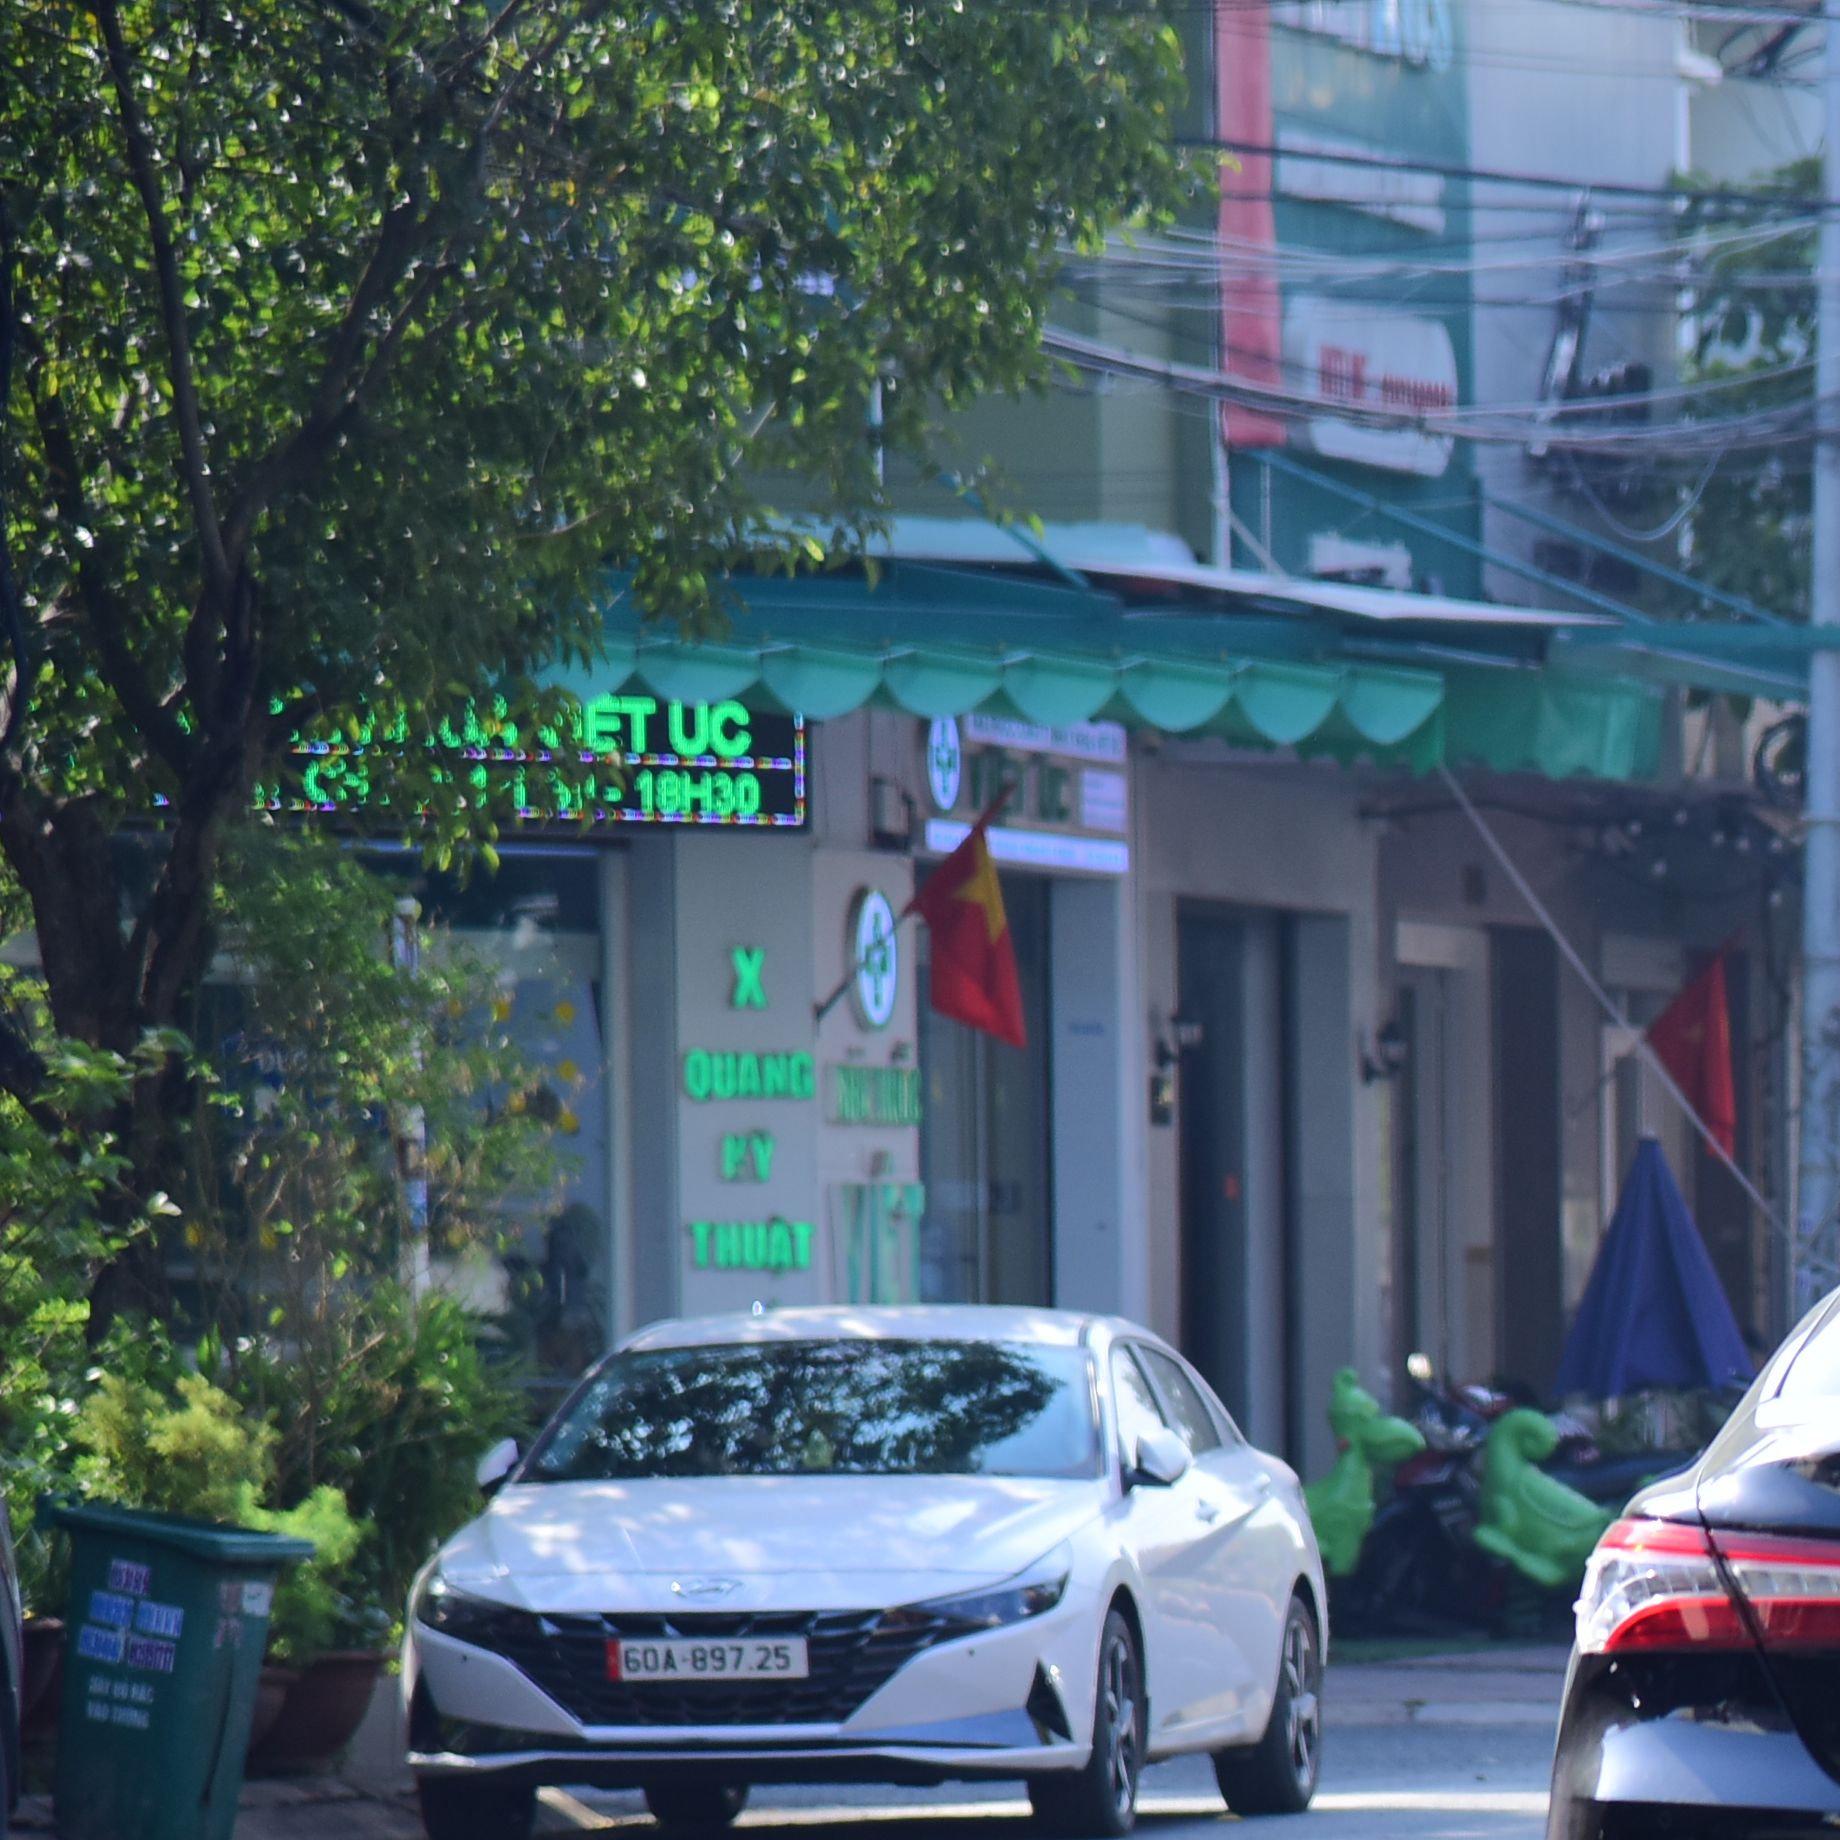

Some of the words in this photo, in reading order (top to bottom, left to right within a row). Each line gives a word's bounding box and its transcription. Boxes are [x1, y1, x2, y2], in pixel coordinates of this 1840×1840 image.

[634, 769, 761, 816] 18H30
[731, 946, 768, 1010] X
[684, 1048, 815, 1101] QUANG
[689, 1214, 816, 1275] THUẬT
[623, 1645, 792, 1674] 60A-897.25
